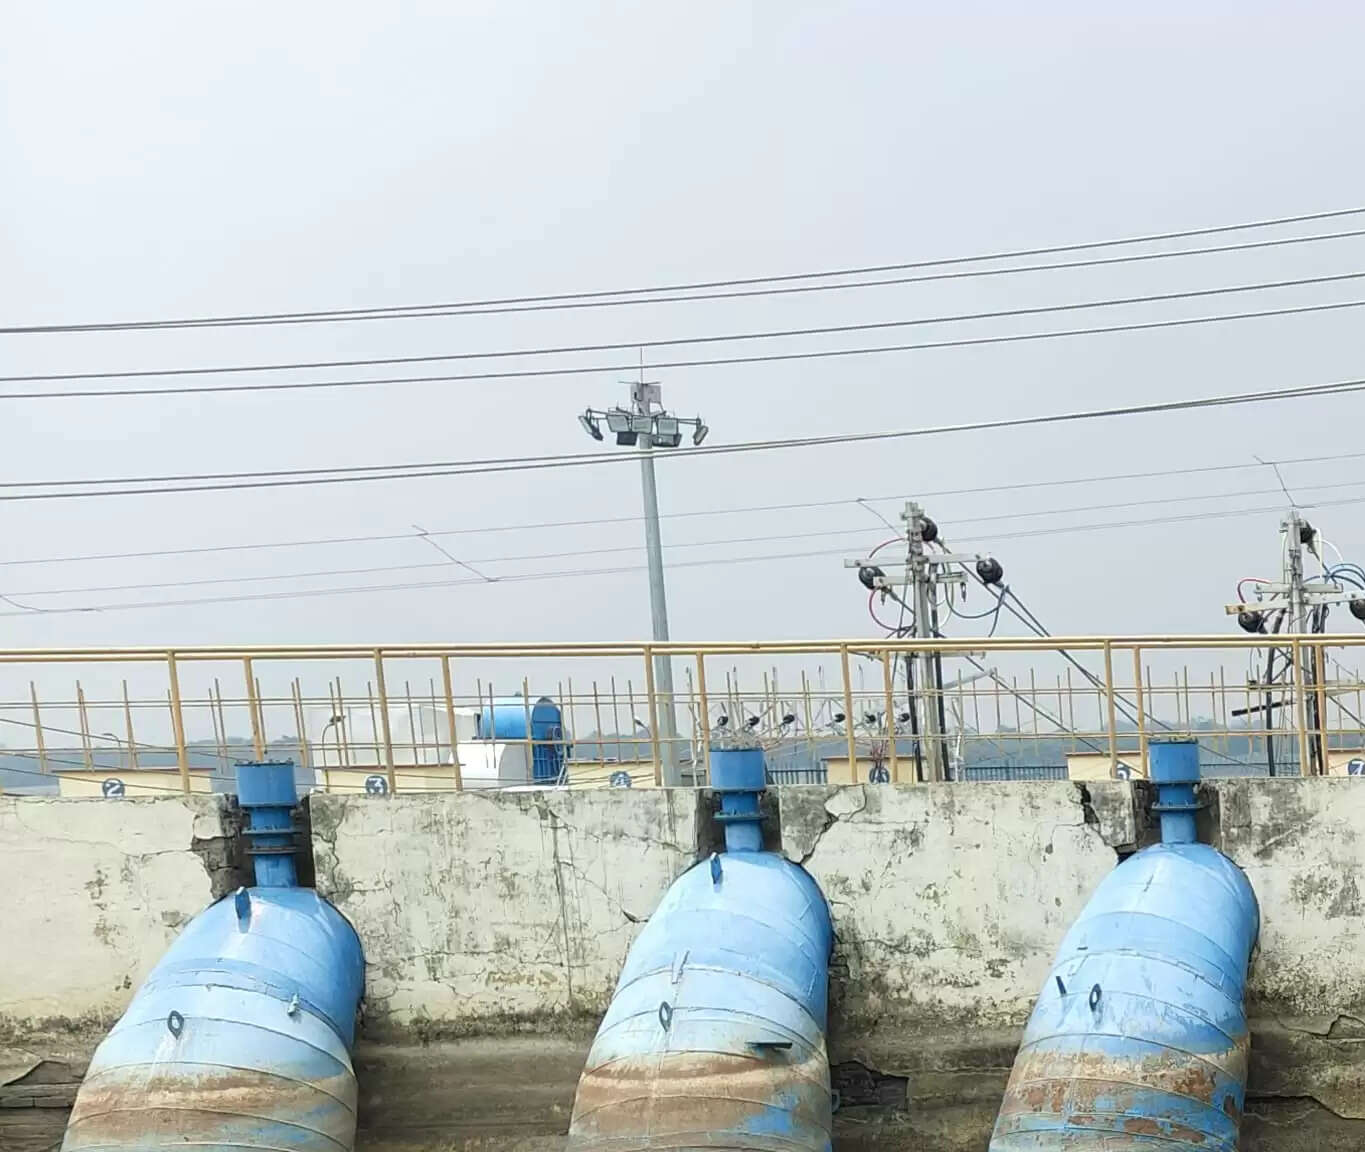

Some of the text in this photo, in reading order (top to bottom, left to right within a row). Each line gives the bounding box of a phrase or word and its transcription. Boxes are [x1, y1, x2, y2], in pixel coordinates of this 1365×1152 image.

[1351, 760, 1365, 776] 7
[105, 780, 122, 797] 2
[368, 777, 385, 793] 3
